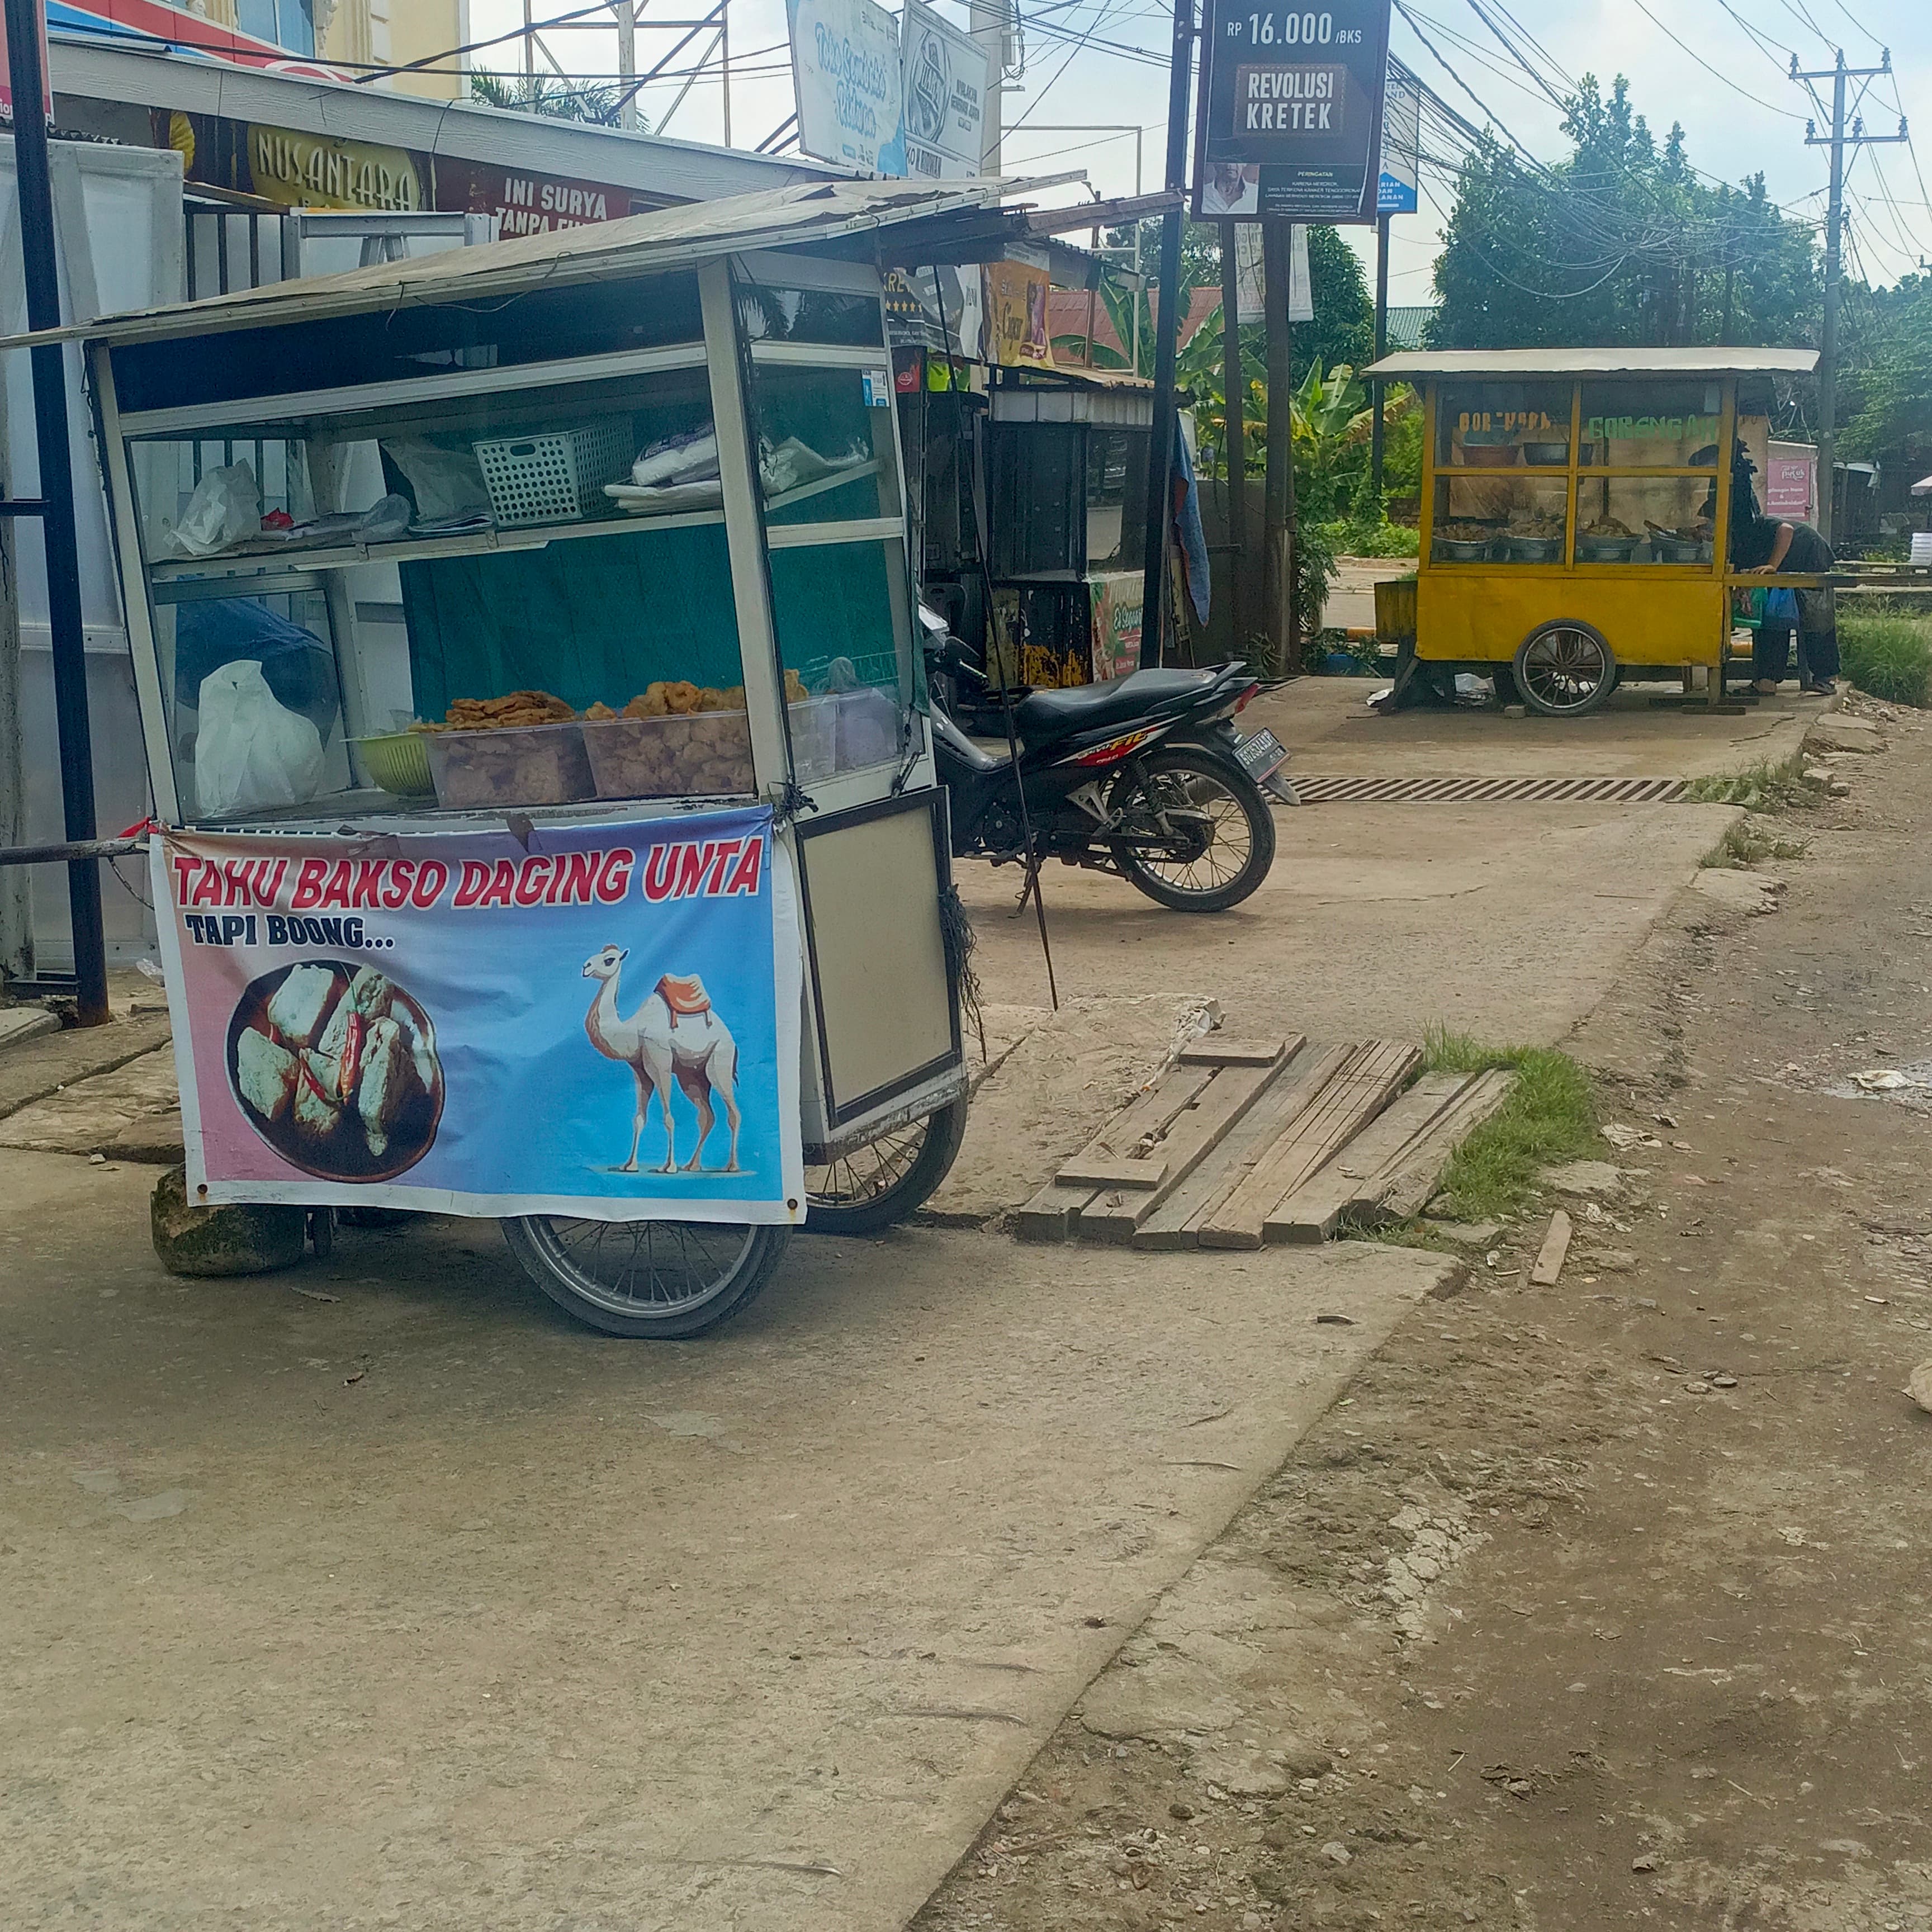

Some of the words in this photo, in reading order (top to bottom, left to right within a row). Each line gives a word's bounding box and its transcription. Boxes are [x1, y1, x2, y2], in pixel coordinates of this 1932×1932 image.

[1227, 22, 1242, 36] RP
[1249, 12, 1332, 44] 16.000
[1335, 30, 1362, 44] /BKS
[815, 21, 842, 78] Toko
[1248, 72, 1334, 98] REVOLUSI
[1246, 103, 1332, 129] KRETEK
[259, 132, 411, 211] NUSANTARA
[505, 178, 534, 206] INI
[541, 184, 607, 220] SURYA
[495, 207, 550, 235] TANPA
[173, 856, 288, 907] TAHU
[291, 858, 448, 910] BAKSO
[452, 847, 634, 908] DAGING
[643, 836, 763, 902] UNTA
[184, 913, 258, 946] TAPI
[266, 913, 395, 949] BOONG...
